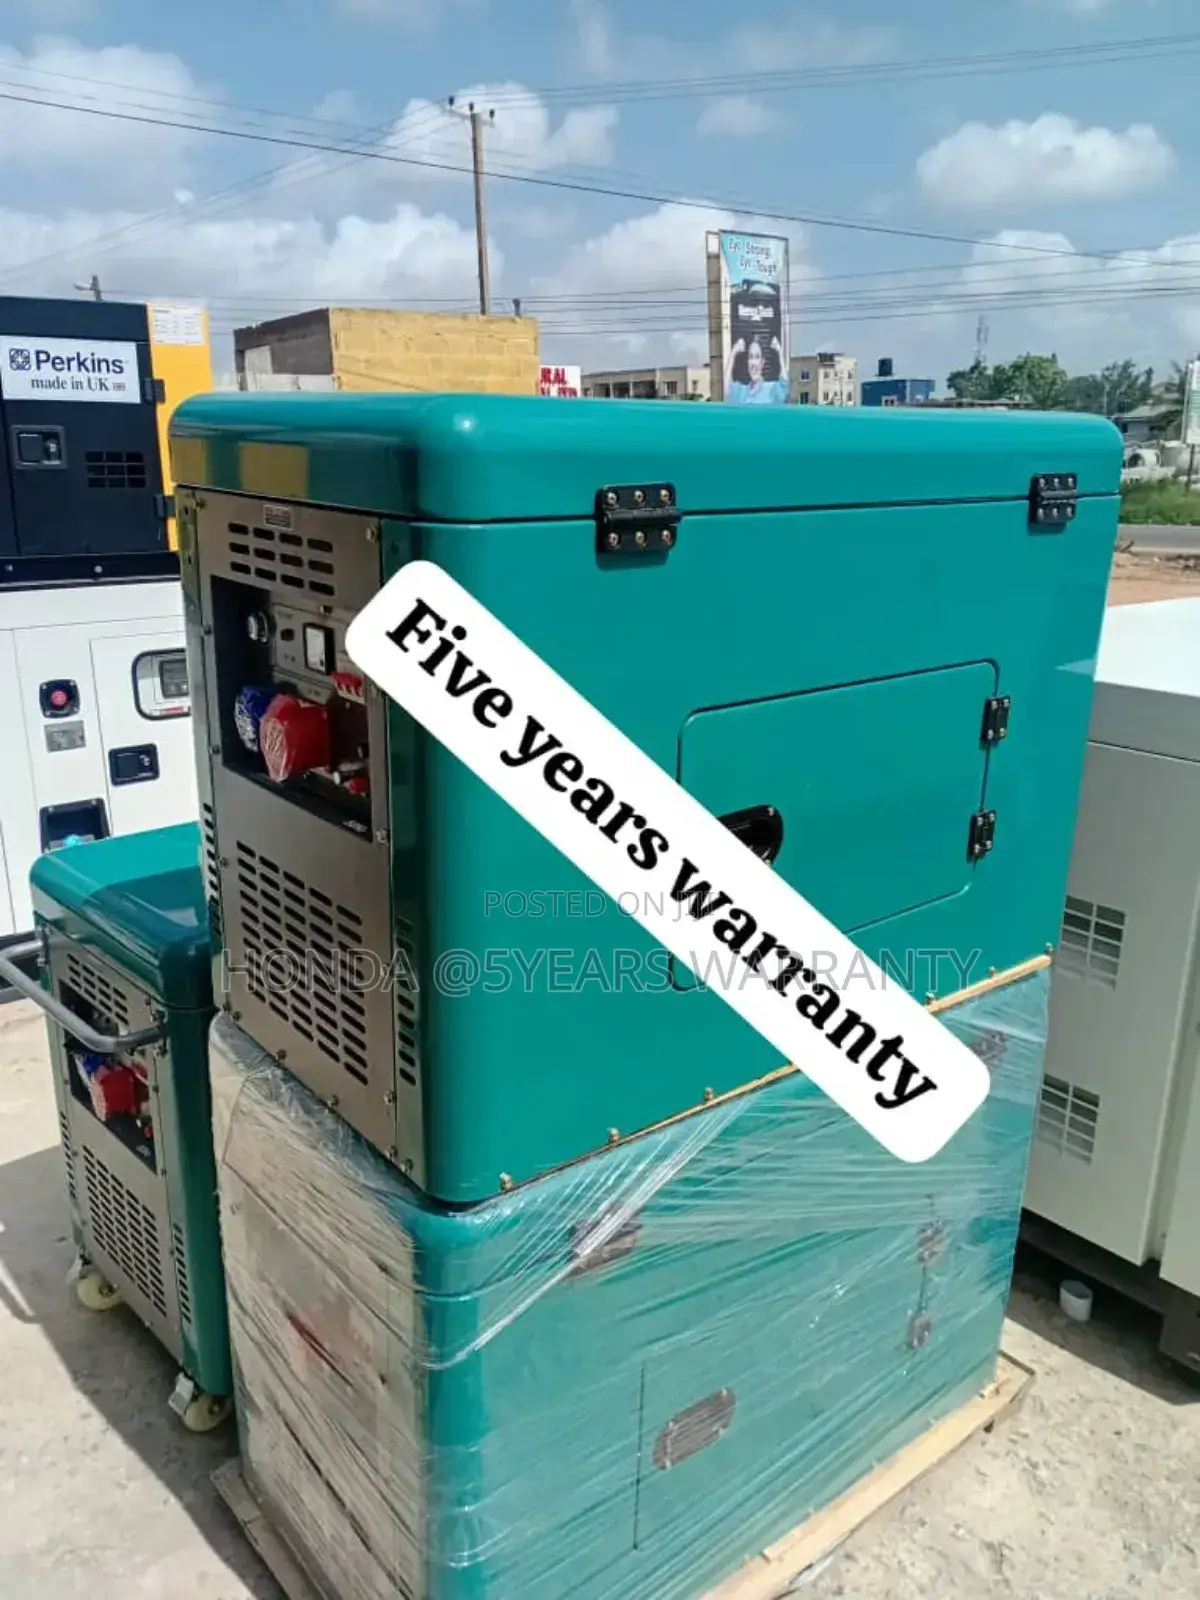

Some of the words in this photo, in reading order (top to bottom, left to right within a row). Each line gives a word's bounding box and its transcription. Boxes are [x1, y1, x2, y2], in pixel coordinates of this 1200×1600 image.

[35, 350, 124, 374] Perkins
[31, 375, 68, 391] made
[71, 375, 83, 391] in
[88, 376, 109, 392] UK
